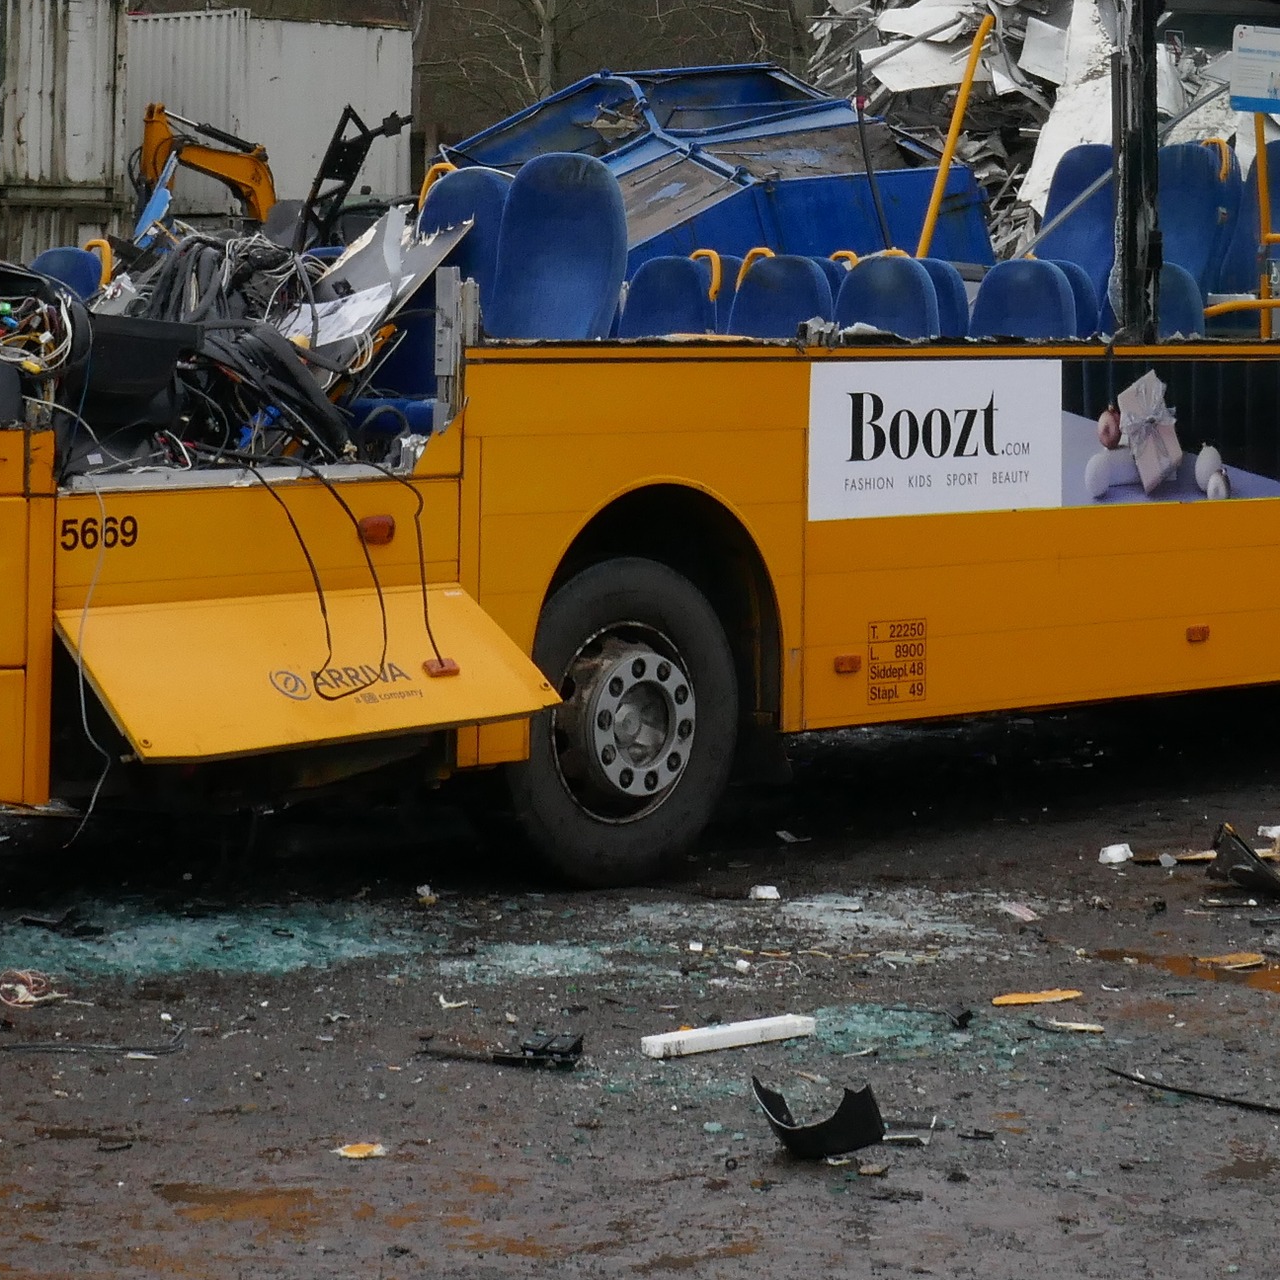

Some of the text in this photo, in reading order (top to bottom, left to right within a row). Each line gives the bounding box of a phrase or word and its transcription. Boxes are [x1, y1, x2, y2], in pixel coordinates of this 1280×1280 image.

[844, 470, 1030, 491] FASHION KIDS SPORT BEAUTY
[61, 515, 138, 551] 5669
[889, 622, 925, 638] 22250
[895, 643, 924, 658] 8900
[909, 661, 924, 676] 48
[311, 662, 412, 691] ARRIVA
[379, 688, 424, 702] company
[909, 682, 924, 696] 49
